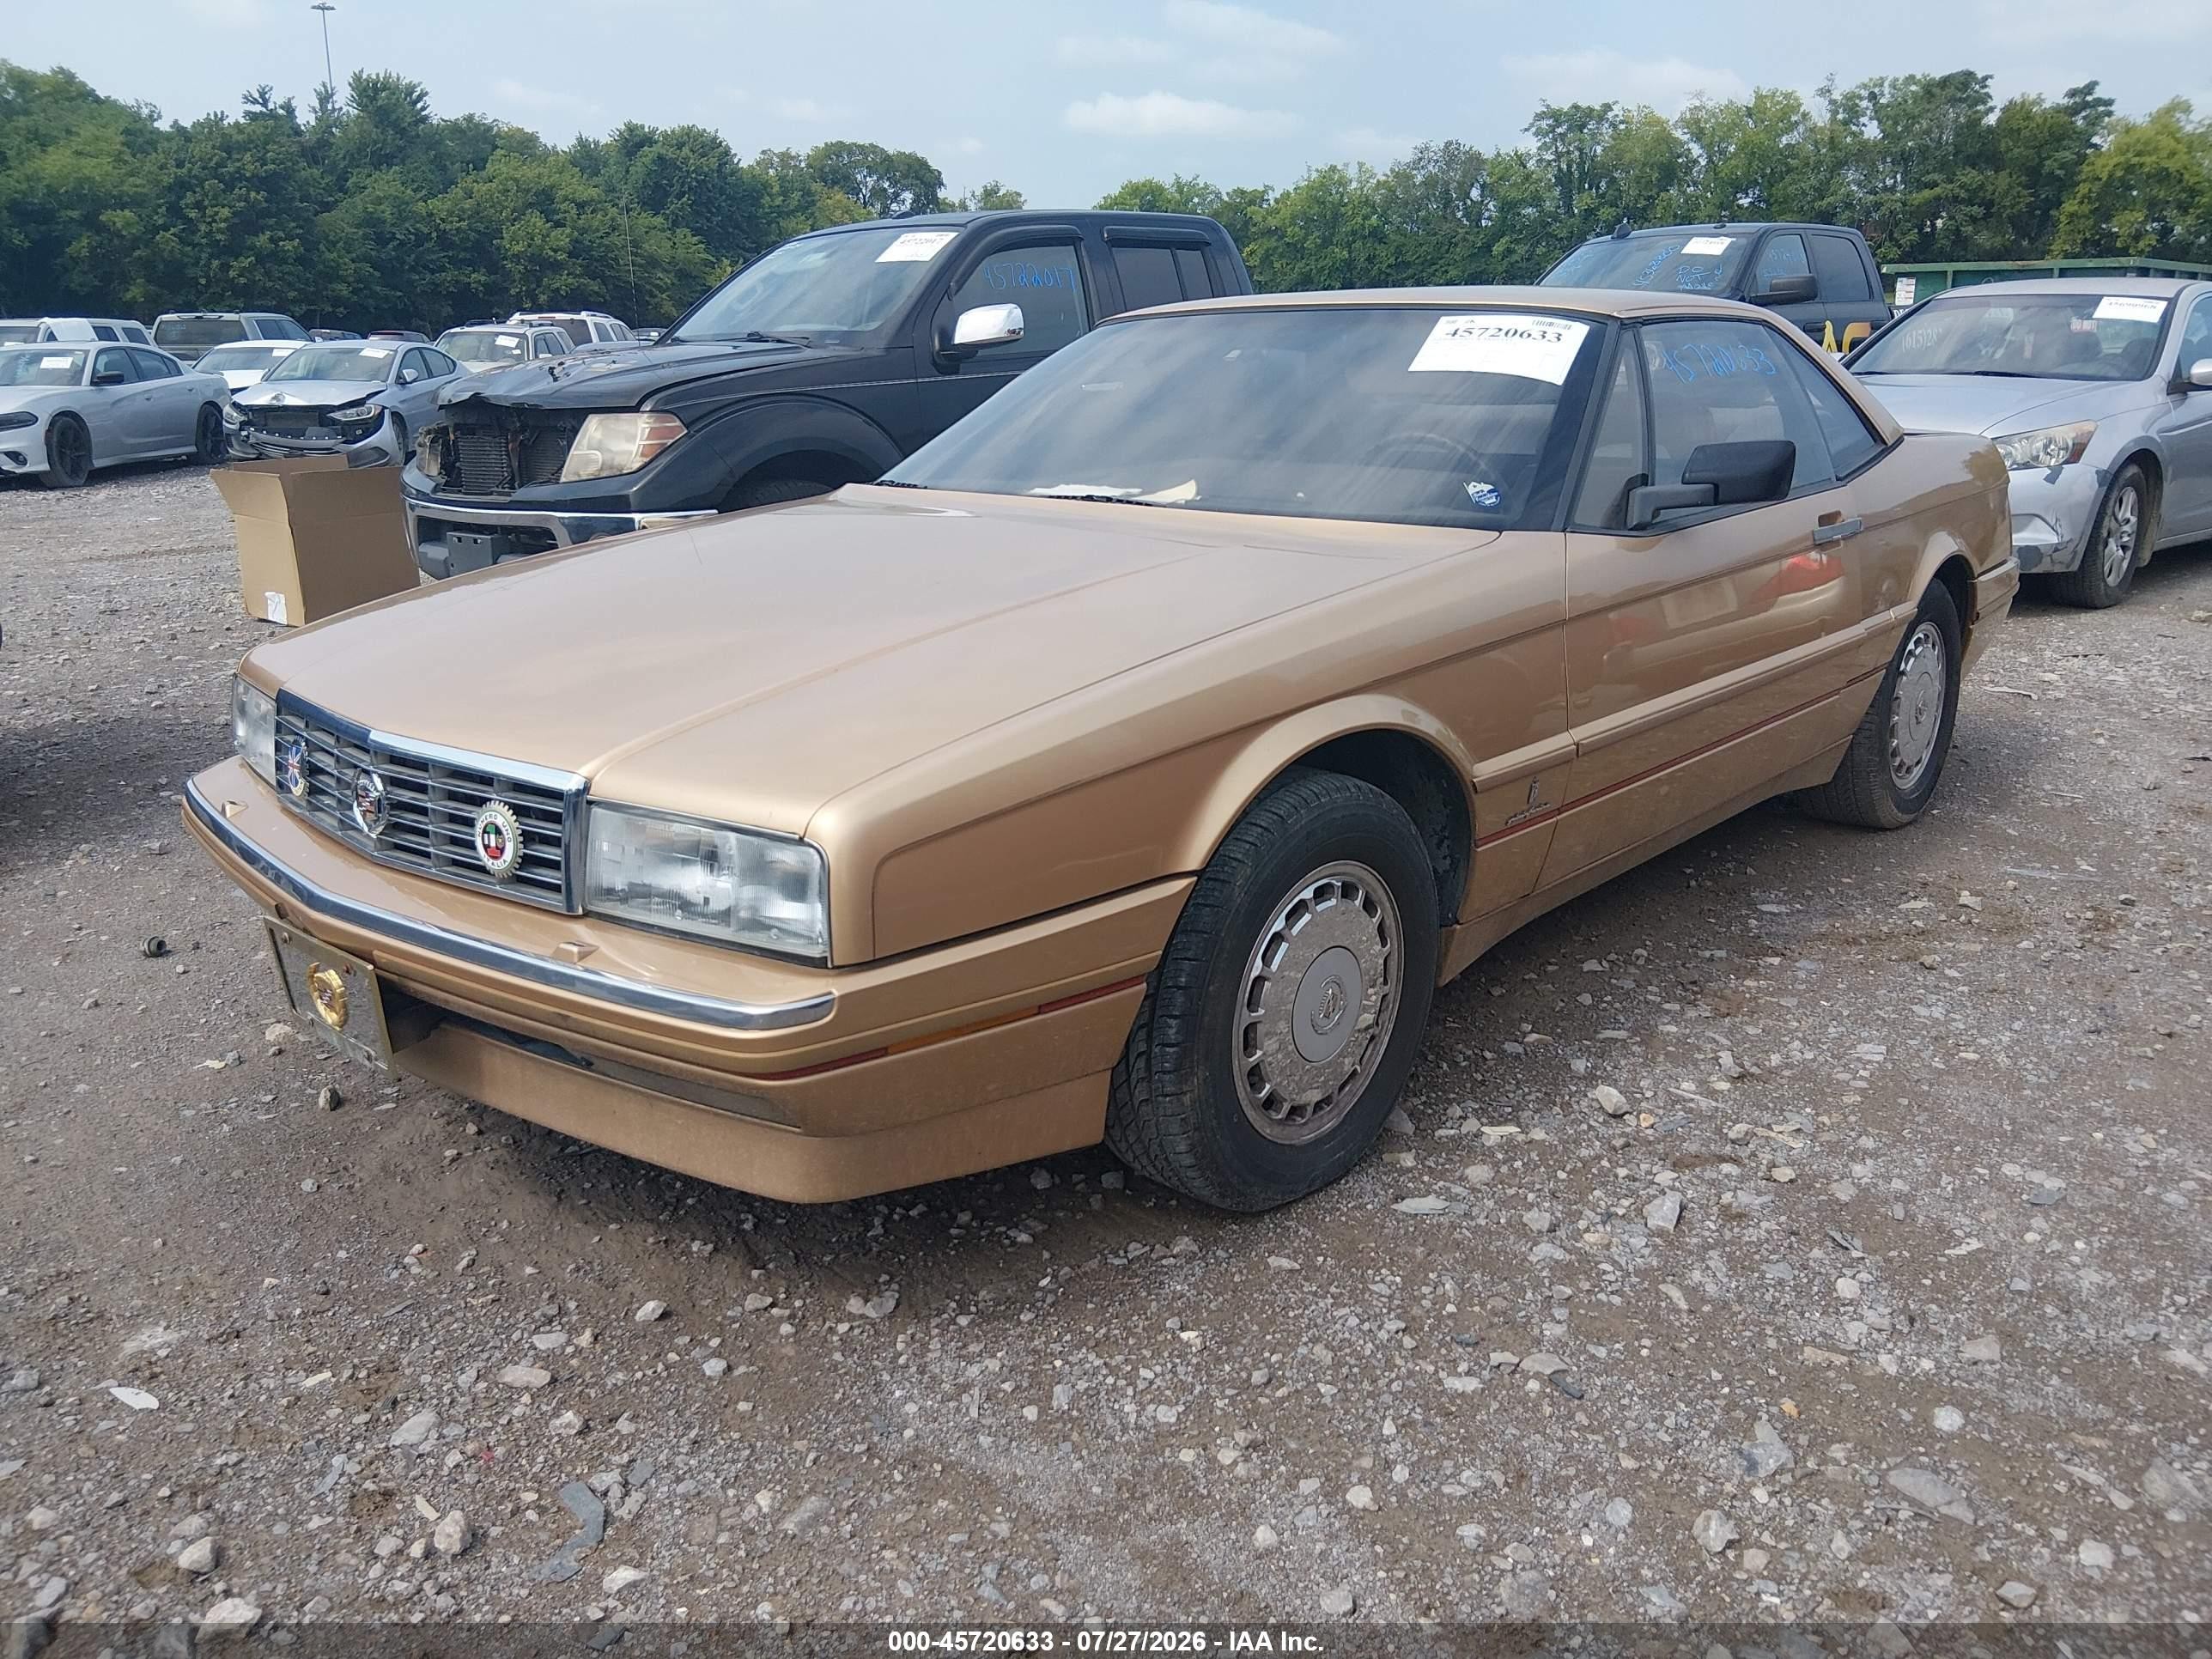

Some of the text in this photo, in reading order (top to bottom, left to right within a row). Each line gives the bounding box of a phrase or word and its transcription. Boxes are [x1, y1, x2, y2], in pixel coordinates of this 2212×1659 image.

[983, 262, 1077, 294] 45722017
[1445, 327, 1563, 343] 45720633
[477, 813, 513, 843] NUMERO UNO
[483, 854, 508, 868] ITALIA
